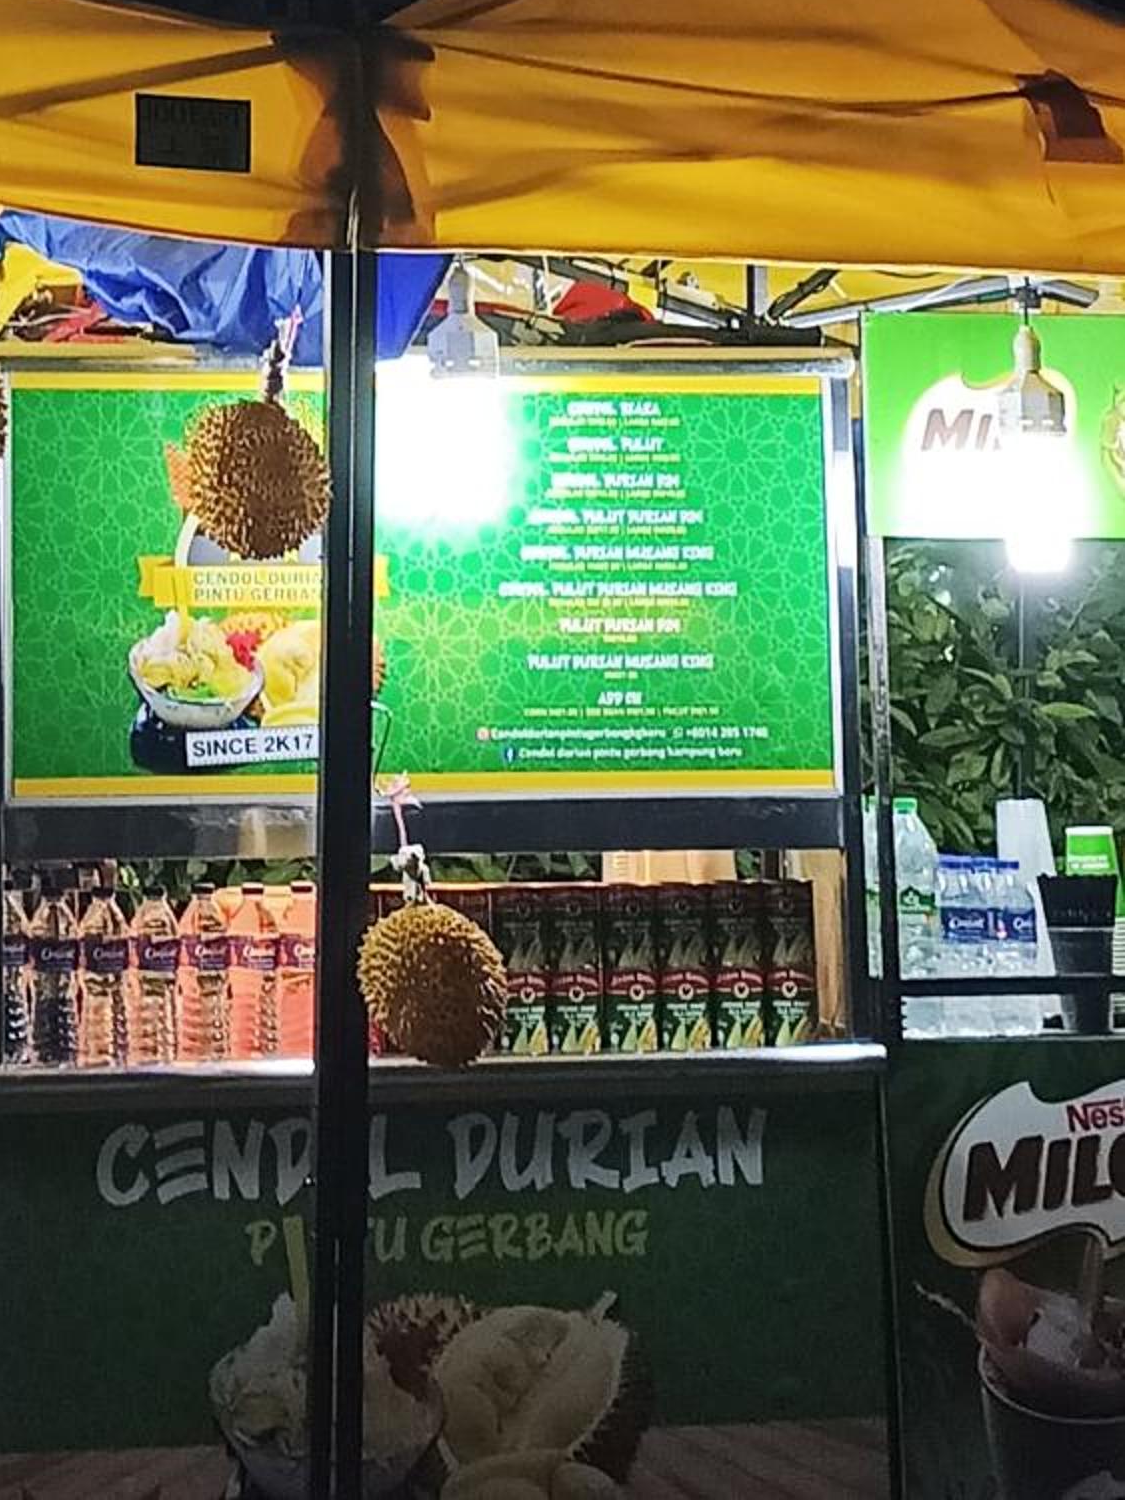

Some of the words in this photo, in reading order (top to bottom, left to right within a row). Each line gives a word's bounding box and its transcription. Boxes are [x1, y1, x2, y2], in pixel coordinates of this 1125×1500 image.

[193, 570, 266, 585] CENDOL
[268, 570, 321, 585] DURIA
[194, 587, 244, 602] PINTU
[250, 587, 318, 602] GERBA
[191, 736, 257, 758] SINCE
[263, 733, 314, 753] 2K17
[1065, 1098, 1125, 1133] Nes
[95, 1113, 421, 1206] CENDL
[447, 1105, 767, 1196] DURIAN
[420, 1209, 650, 1261] GERBANG
